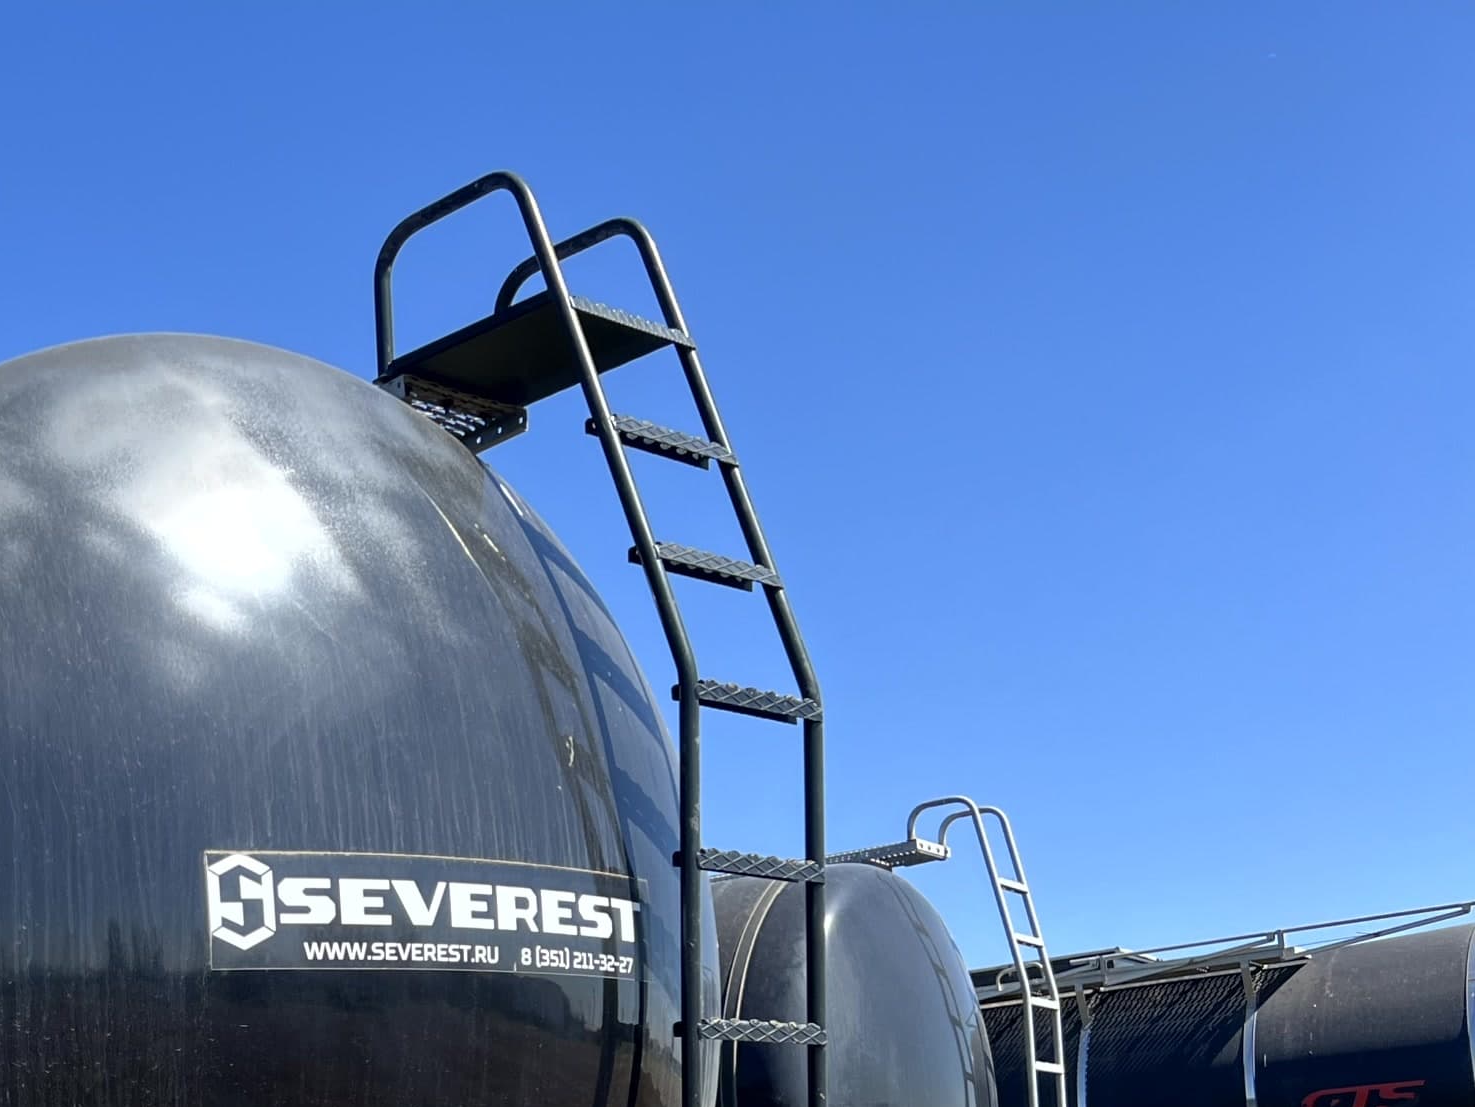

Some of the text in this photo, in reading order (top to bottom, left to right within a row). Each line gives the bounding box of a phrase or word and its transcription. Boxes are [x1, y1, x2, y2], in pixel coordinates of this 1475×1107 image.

[277, 877, 640, 943] SEVEREST
[303, 941, 633, 974] WWW.SEVEREST.RU 8 (351) 211-32-27
